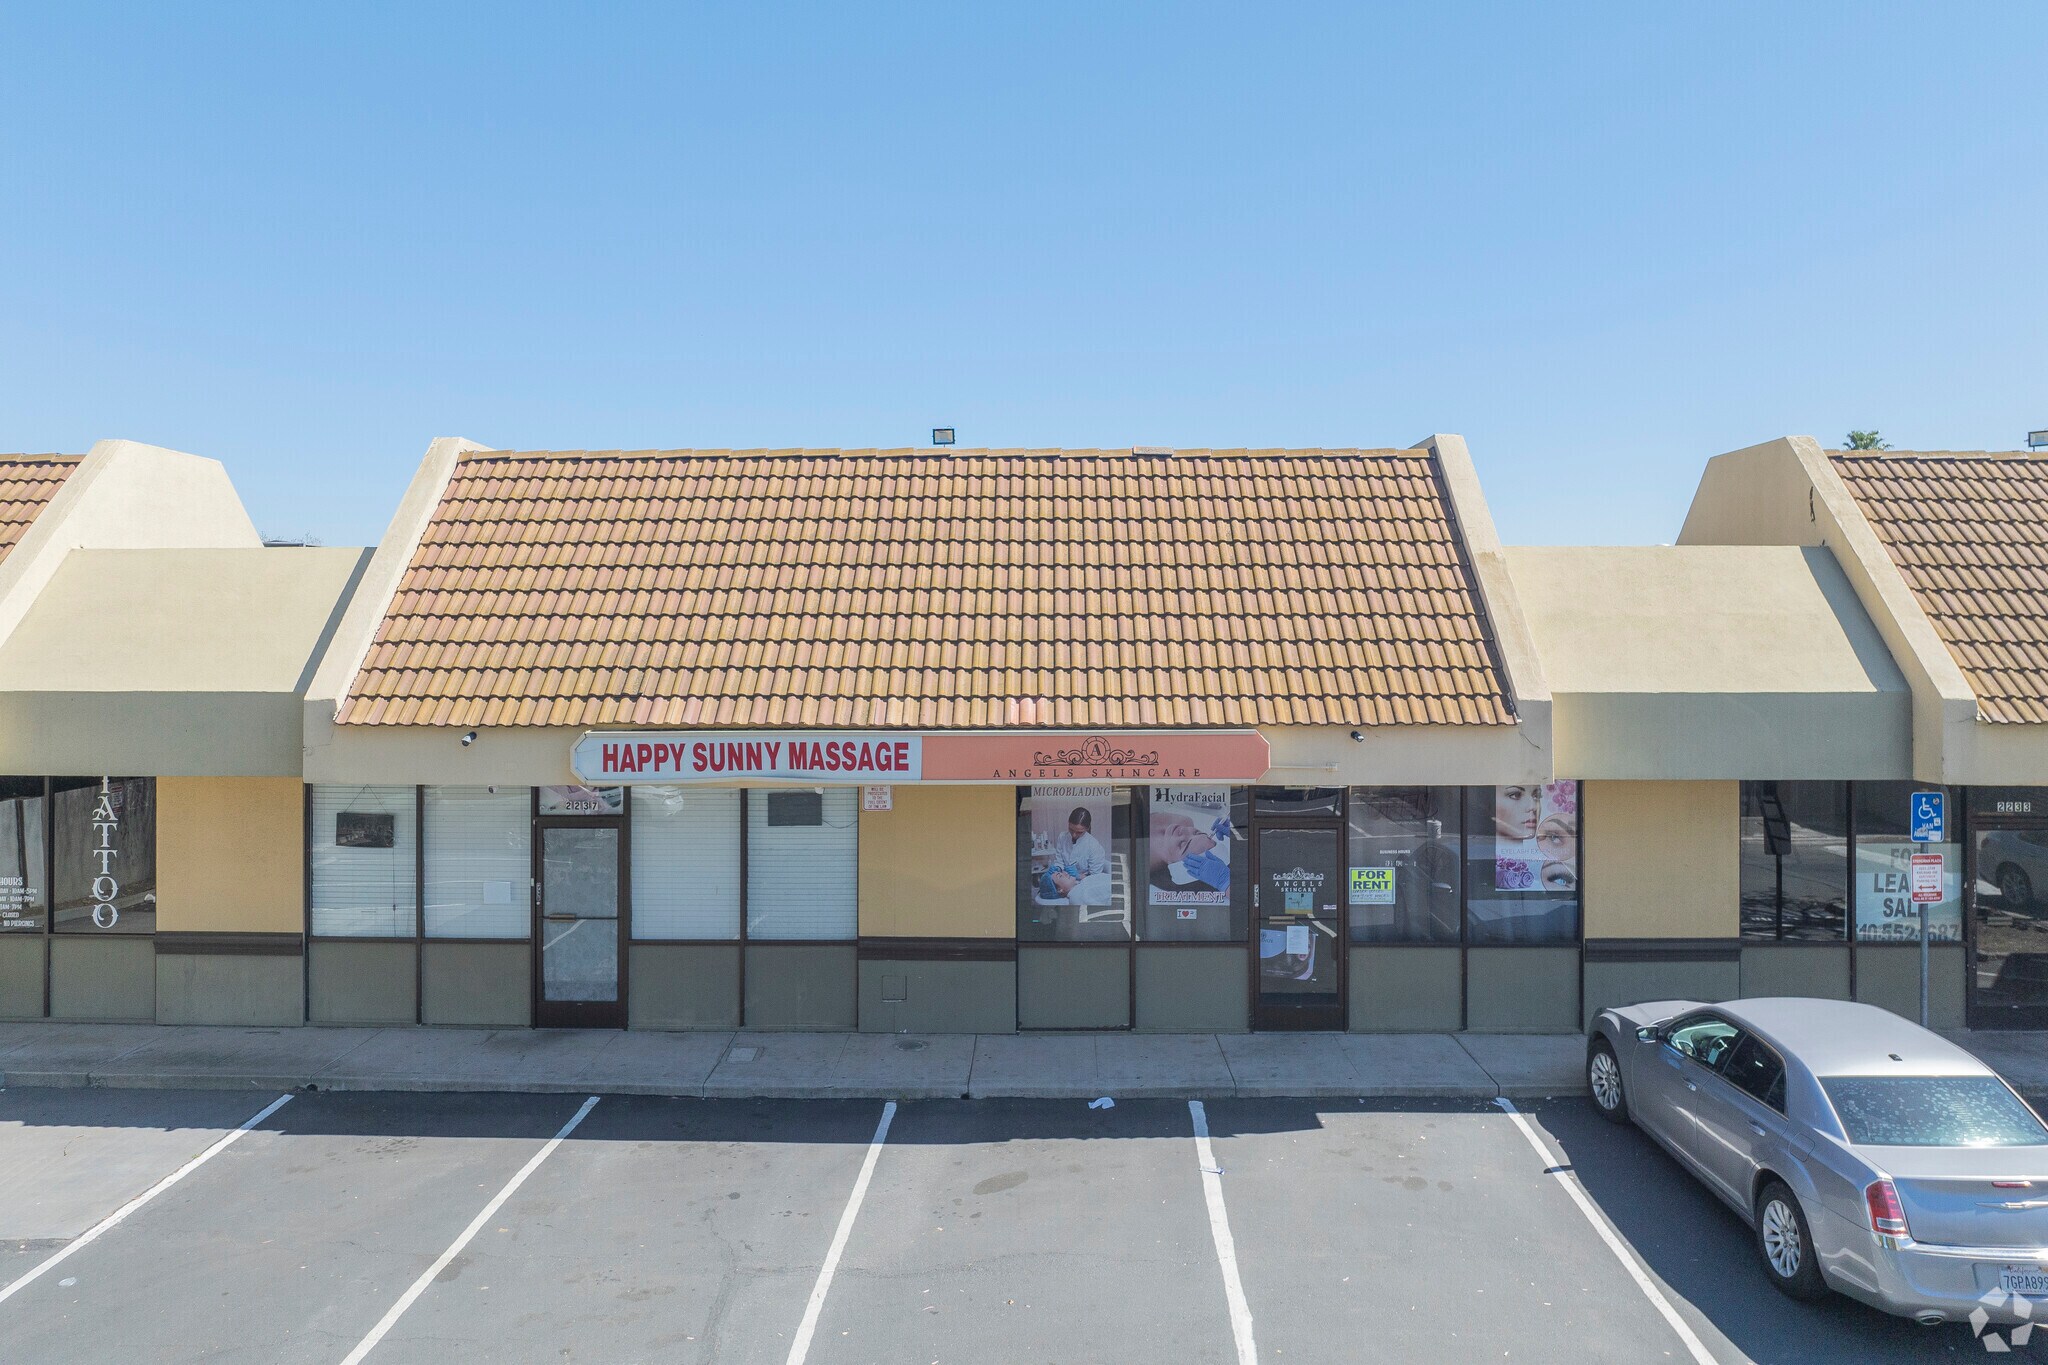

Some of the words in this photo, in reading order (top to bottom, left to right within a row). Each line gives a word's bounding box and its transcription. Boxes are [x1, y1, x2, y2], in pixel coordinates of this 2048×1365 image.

[602, 743, 686, 773] HAPPY
[692, 742, 781, 772] SUNNY
[788, 741, 909, 772] MASSAGE
[993, 768, 1074, 778] ANGELS
[1091, 768, 1201, 778] SKINCARE
[1033, 786, 1111, 797] MICROBLADING
[1155, 787, 1226, 804] HydraFacial
[566, 802, 598, 810] 2237
[1998, 802, 2030, 811] 2233
[1358, 870, 1386, 879] FOR
[1353, 880, 1391, 889] RENT
[1873, 873, 1910, 893] LEA
[1154, 891, 1226, 904] TREATMENT
